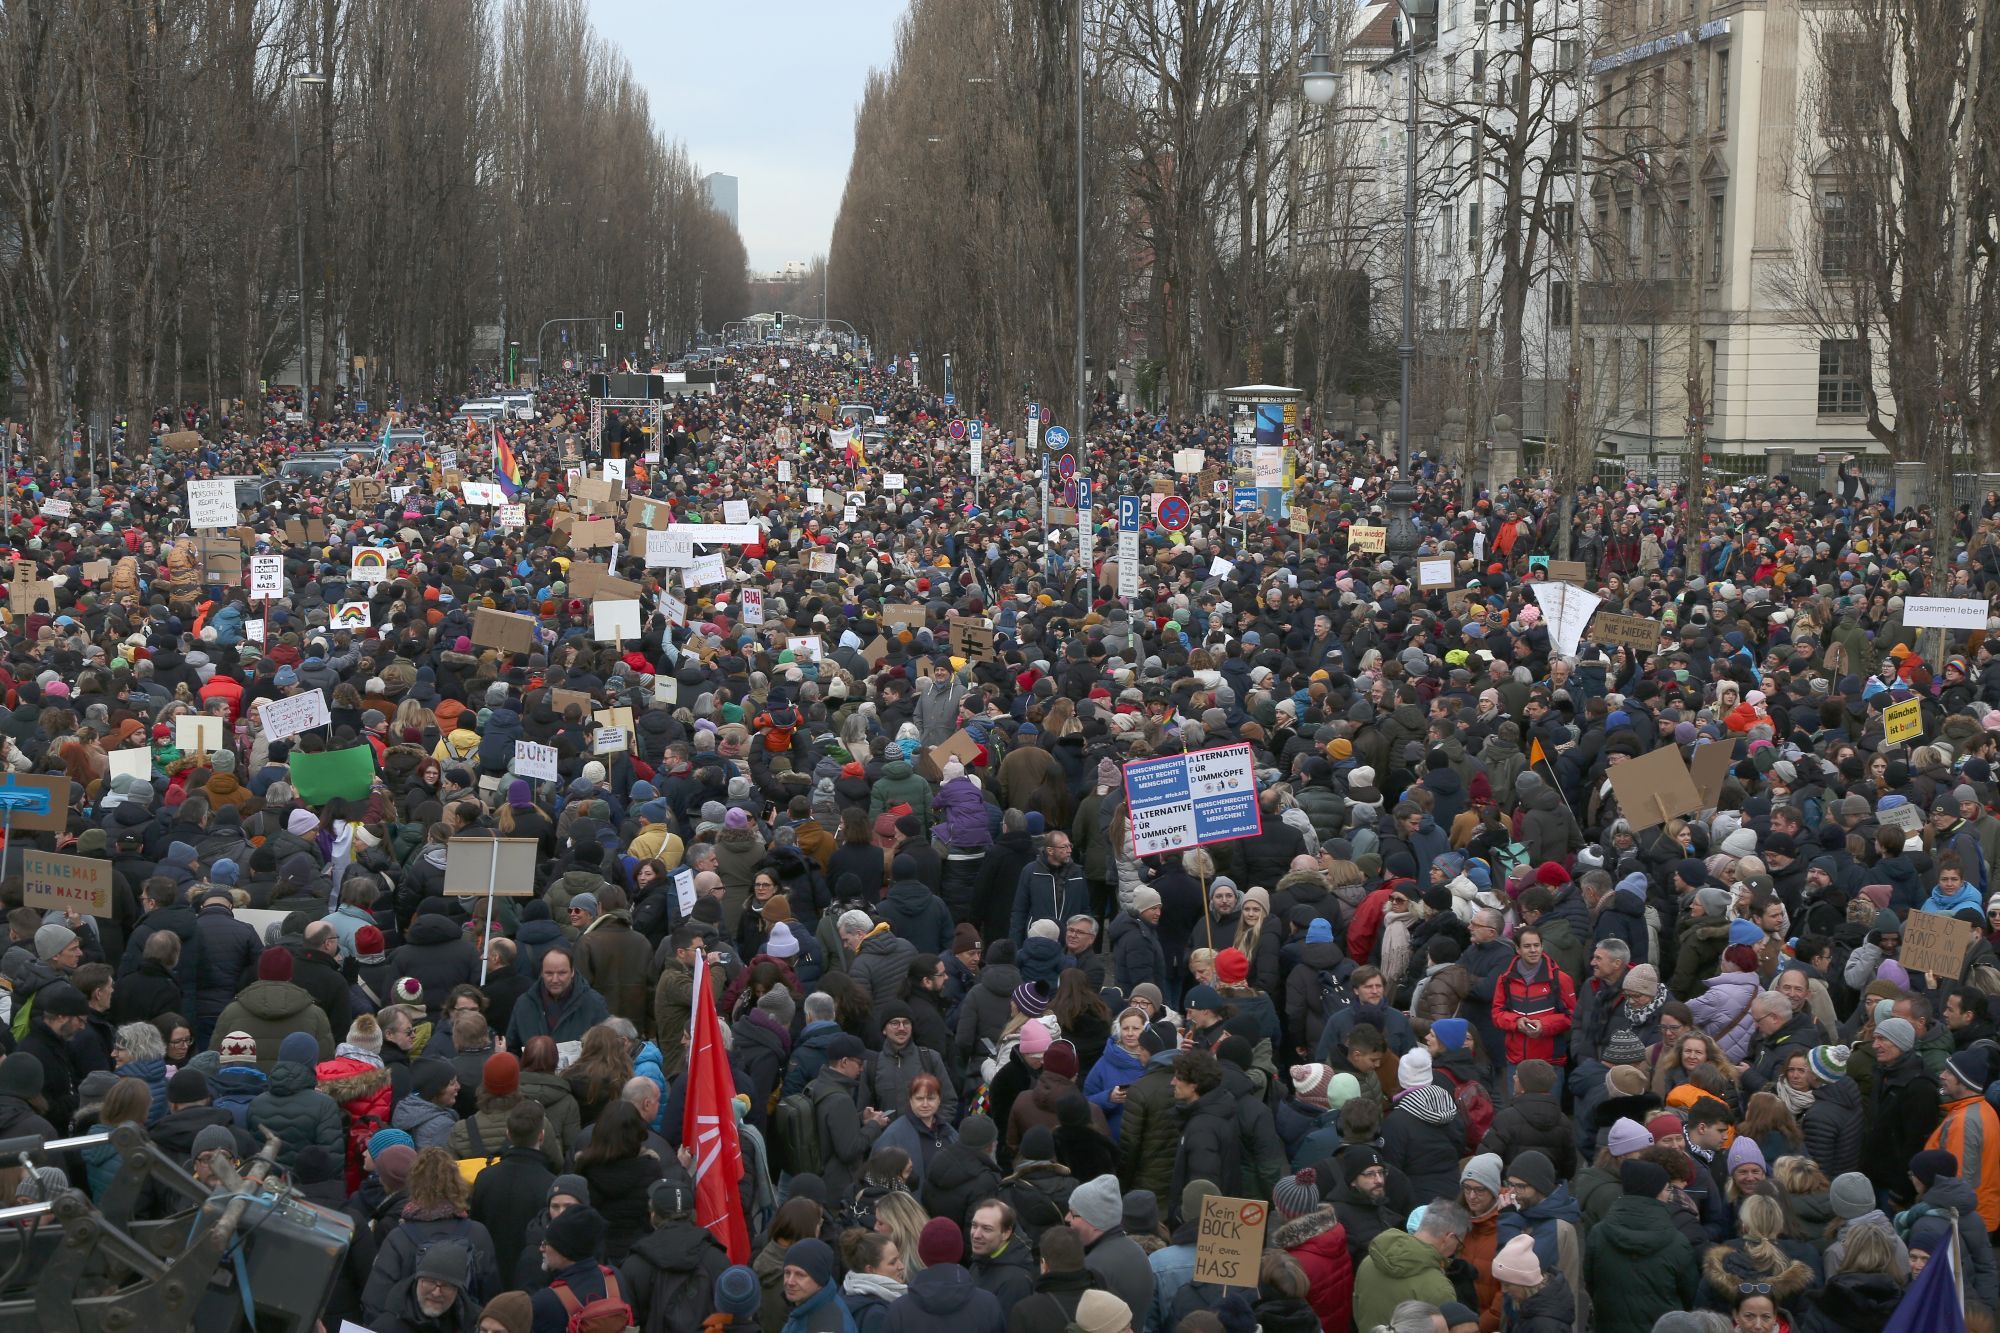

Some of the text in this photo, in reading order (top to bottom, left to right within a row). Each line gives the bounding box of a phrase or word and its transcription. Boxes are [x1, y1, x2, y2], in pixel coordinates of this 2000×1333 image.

[1030, 404, 1036, 417] P
[970, 423, 978, 438] P
[1256, 464, 1269, 472] DAS
[1257, 467, 1281, 477] SCHLOSS
[352, 481, 382, 498] YES
[1079, 482, 1087, 506] P
[220, 501, 234, 510] ALS
[1121, 500, 1133, 527] P
[1352, 528, 1384, 538] Nie wieder
[1231, 537, 1238, 547] P
[255, 564, 278, 573] DÖNER
[1908, 605, 1985, 615] zusammen leben
[1604, 623, 1652, 640] NIE WIEDER
[1888, 705, 1917, 722] München
[1890, 719, 1918, 735] ist bunt!
[516, 743, 557, 764] BUNT
[1127, 759, 1185, 776] MENSCHENRECHTE
[1134, 769, 1180, 782] STATT RECHTE
[1138, 778, 1173, 789] MENSCHEN
[1195, 794, 1254, 810] MENSCHENRECHTE
[1202, 803, 1248, 816] STATT RECHTE
[1206, 812, 1241, 823] MENSCHEN
[26, 880, 97, 901] FÜR NAZIS
[1912, 911, 1956, 936] THERE IS
[1944, 939, 1954, 953] IN
[1905, 947, 1961, 976] MANKIND
[1205, 1200, 1234, 1220] Kein
[1202, 1218, 1244, 1240] BOCK
[1198, 1242, 1240, 1256] auf euren
[1196, 1257, 1240, 1278] HASS
